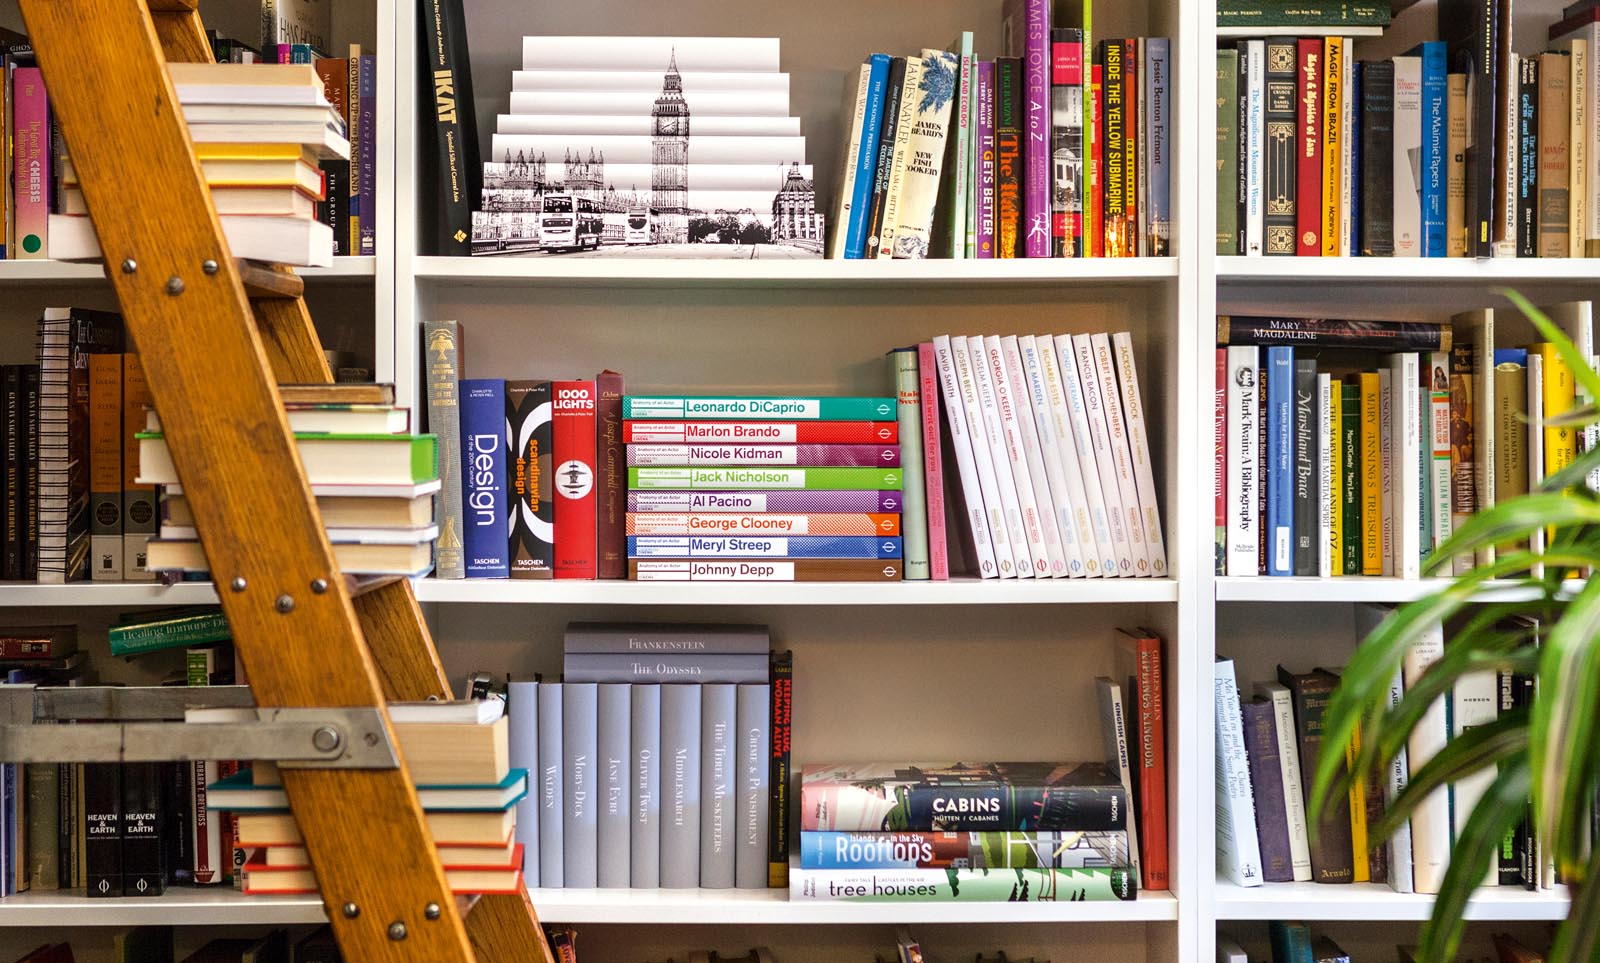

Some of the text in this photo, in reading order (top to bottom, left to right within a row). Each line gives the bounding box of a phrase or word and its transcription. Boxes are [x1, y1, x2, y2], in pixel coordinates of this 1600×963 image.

[1330, 44, 1338, 78] MAGIC
[434, 70, 456, 124] IKAT
[960, 96, 968, 128] ECOLOGY
[31, 132, 40, 148] Great
[915, 120, 942, 130] JAMES
[1108, 45, 1122, 214] INSIDE THE YELLOW SUBMARINE
[1328, 112, 1336, 144] BRAZIL
[363, 110, 372, 196] Growing Whole
[913, 158, 932, 167] FISH
[915, 151, 933, 159] NEW
[1000, 136, 1018, 176] The
[30, 160, 40, 203] CHEESE
[984, 136, 993, 236] IT GETS BETTER
[1254, 328, 1316, 340] MAGDALENE
[1270, 320, 1300, 330] MARY
[939, 349, 955, 398] DAVID SMITH
[956, 350, 974, 403] JOSEPH BEUYS
[990, 349, 1012, 422] GEORGIA O'KEEFFE
[1026, 348, 1043, 406] BRICE MARDEN
[1080, 346, 1098, 410] FRANCIS BACON
[1120, 346, 1138, 419] JACKSON POLLOCK
[554, 400, 594, 409] LIGHTS
[558, 390, 588, 398] 1000
[686, 402, 806, 414] Leonardo DiCaprio
[1100, 346, 1122, 438] ROBERT RAUSCHENBERG
[687, 426, 780, 437] Marlon Brando
[1298, 390, 1312, 498] Marshland Brace
[690, 448, 782, 458] Nicole Kidman
[1240, 392, 1252, 531] Mark Twain: A Bibliography
[470, 434, 499, 526] Design
[516, 458, 526, 494] design
[530, 440, 540, 512] scandinavian
[694, 472, 789, 482] Jack Nicholson
[1456, 462, 1472, 512] MASTERSON
[692, 496, 752, 506] Al Pacino
[690, 517, 792, 530] George Clooney
[692, 540, 772, 552] Meryl Streep
[692, 564, 774, 576] Johnny Depp
[122, 626, 164, 641] Healing
[166, 621, 210, 635] Immune
[628, 638, 705, 649] FRANKENSTEIN
[631, 663, 702, 674] THE ODYSSEY
[774, 679, 782, 758] WOMAN ALIVE
[783, 679, 791, 725] KEEPING
[1115, 702, 1127, 768] KINGFISH CAPERS
[1214, 678, 1228, 724] Development
[1222, 734, 1231, 754] Early
[1228, 776, 1237, 799] Poetry
[1231, 734, 1239, 748] and
[1234, 749, 1242, 760] the
[546, 766, 557, 809] WALDEN
[574, 755, 586, 818] MOBY-DICK
[609, 758, 620, 815] JANE EYRE
[640, 750, 650, 824] OLIVER TWIST
[675, 748, 687, 826] MIDDLEMARCH
[714, 722, 726, 852] THE THREE MUSKETEERS
[748, 728, 760, 845] CRIME & PUNISHMENT
[88, 814, 118, 822] HEAVEN
[198, 794, 206, 826] DREYFUSS
[932, 798, 1000, 812] CABINS
[836, 836, 932, 862] Rooftops
[830, 876, 936, 896] tree houses
